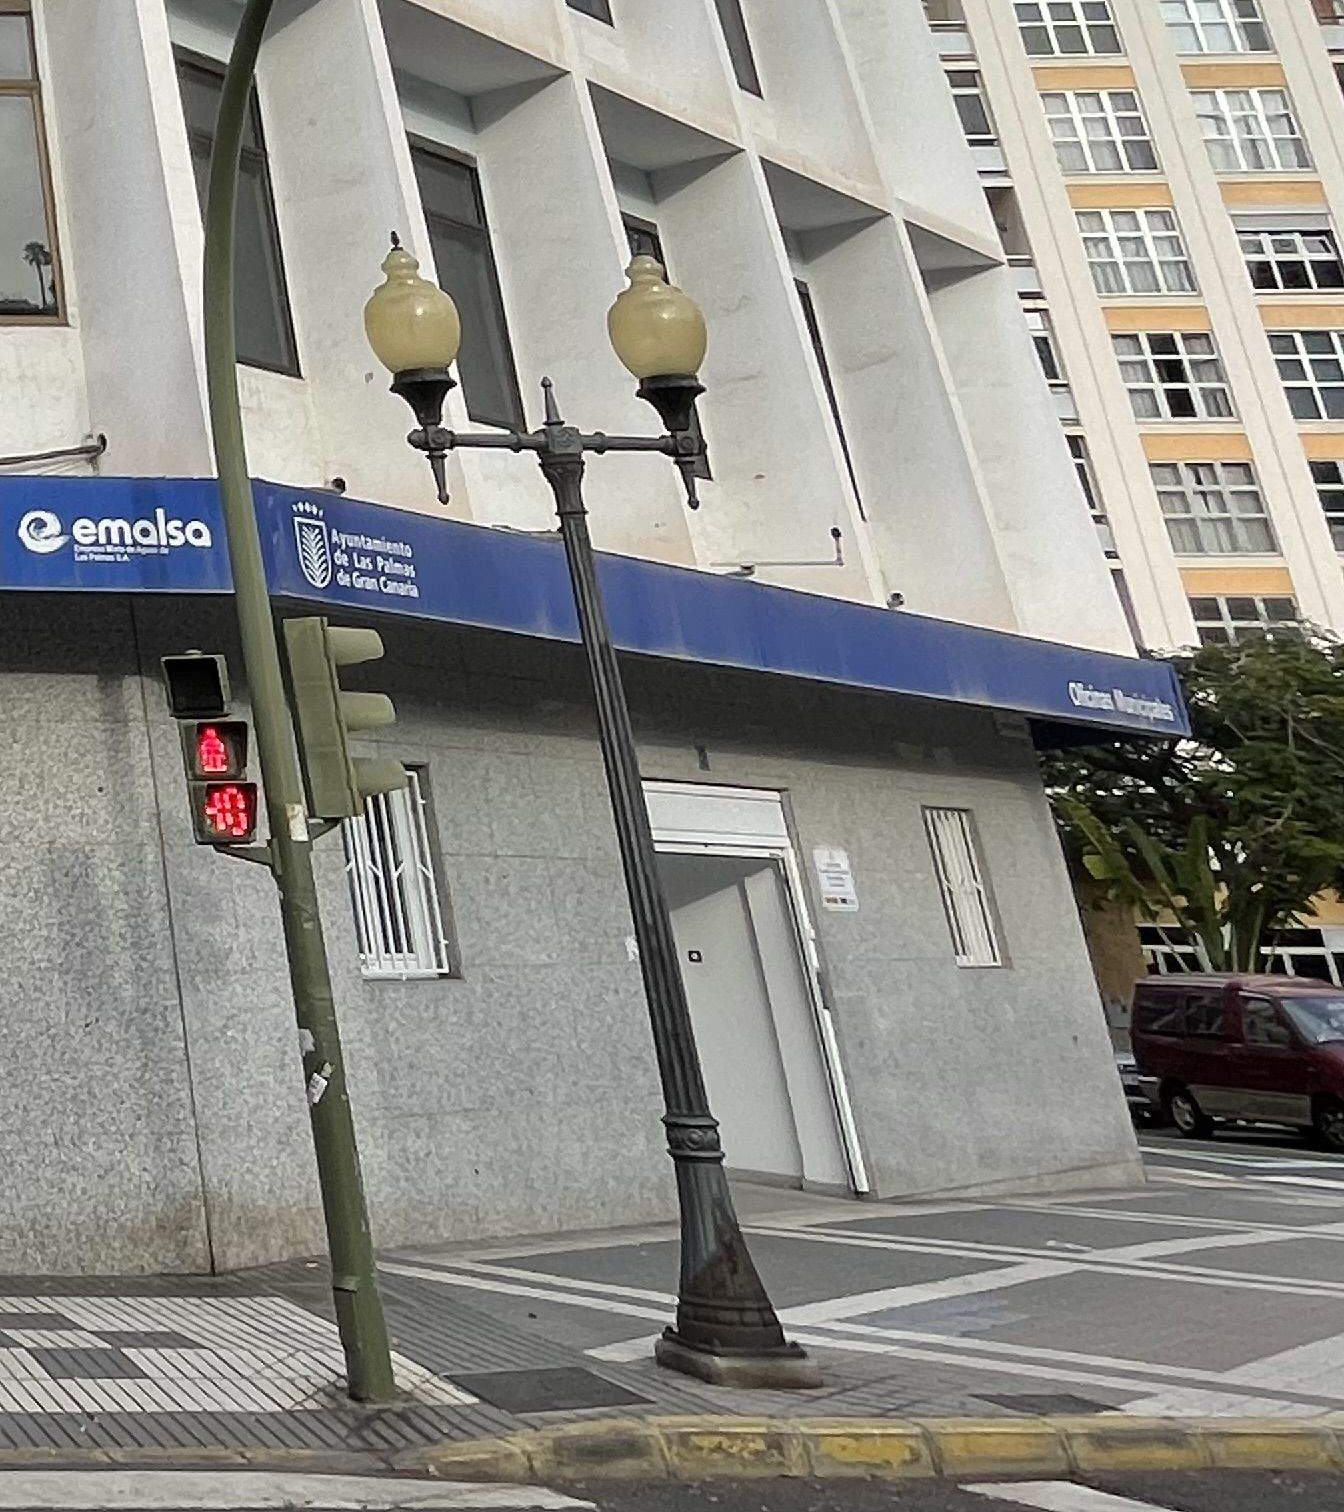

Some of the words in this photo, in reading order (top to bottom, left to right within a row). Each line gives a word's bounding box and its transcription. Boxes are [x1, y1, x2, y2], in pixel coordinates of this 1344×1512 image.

[72, 506, 212, 548] emalsa
[332, 528, 412, 558] Ayuntamiento
[333, 549, 349, 566] de
[353, 552, 373, 571] Las
[376, 555, 416, 578] Palmas
[336, 568, 351, 587] de
[352, 571, 380, 592] Gran
[380, 576, 420, 598] Canaria
